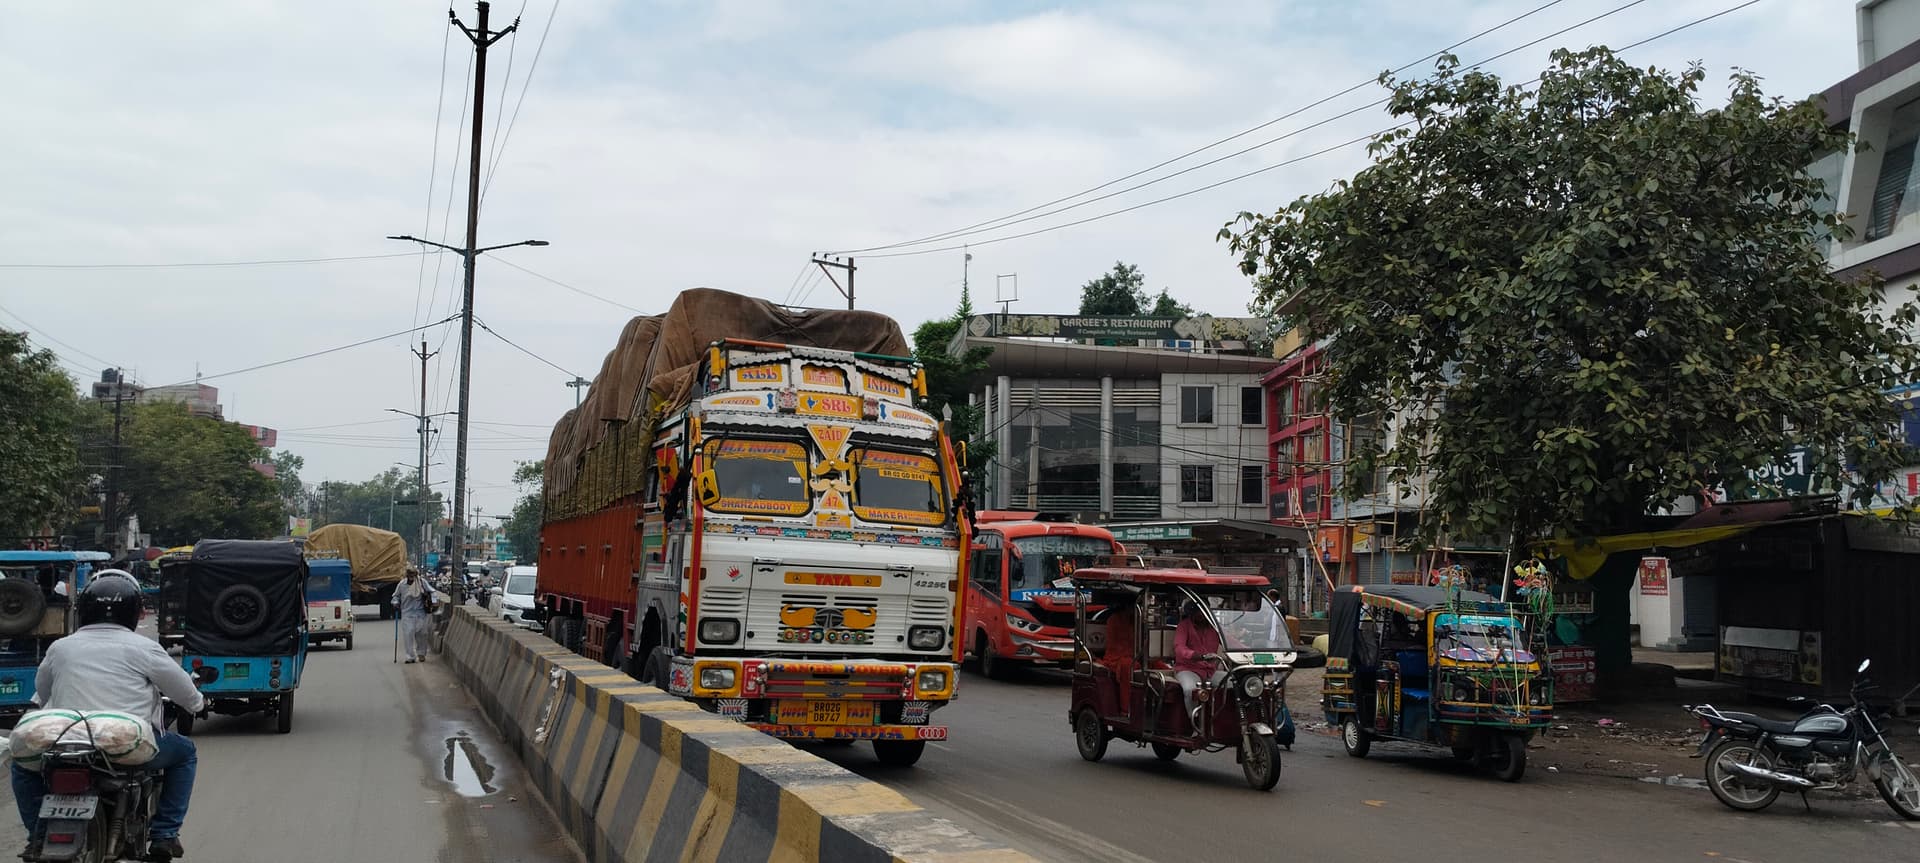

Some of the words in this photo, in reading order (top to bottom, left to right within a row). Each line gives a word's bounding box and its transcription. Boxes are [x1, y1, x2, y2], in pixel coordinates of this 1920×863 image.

[1062, 318, 1108, 327] GARGEE'S
[1110, 319, 1173, 329] RESTAURANT
[867, 377, 900, 395] INDIA
[818, 429, 842, 441] ZAID
[825, 496, 839, 508] 47
[815, 573, 853, 586] TATA
[722, 706, 743, 716] LUCK
[814, 702, 841, 713] BR02G
[905, 708, 925, 717] GOOD
[813, 713, 841, 723] D8747
